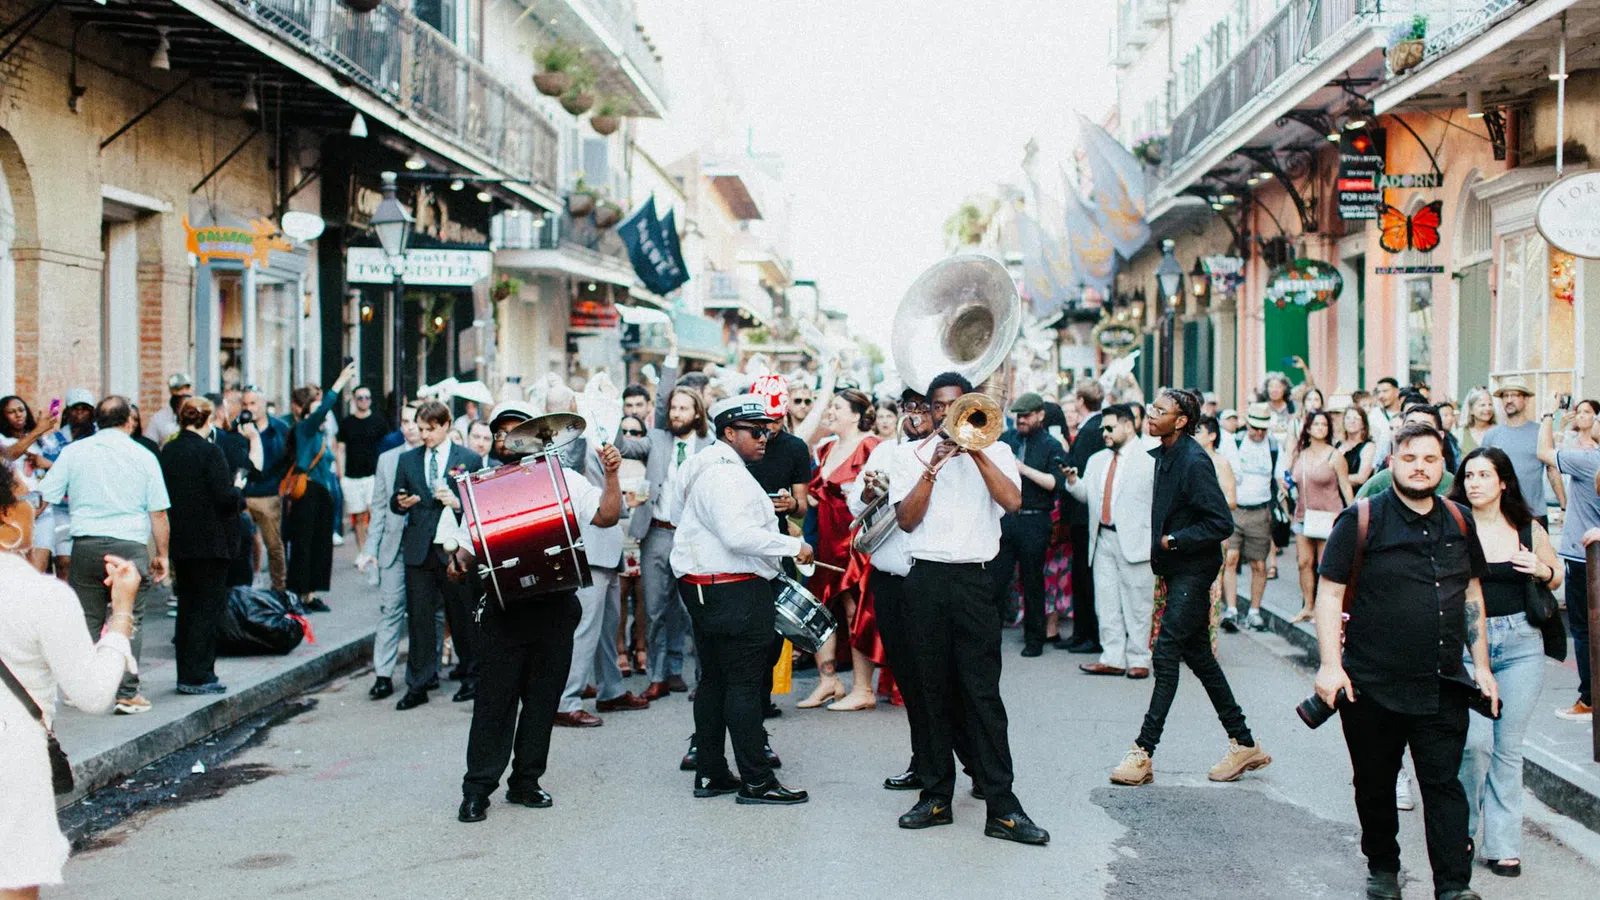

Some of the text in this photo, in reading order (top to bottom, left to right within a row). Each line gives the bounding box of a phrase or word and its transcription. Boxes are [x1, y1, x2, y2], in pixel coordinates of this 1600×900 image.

[1379, 175, 1437, 187] ADORN
[1341, 193, 1358, 201] FOR
[356, 263, 480, 277] TWO SISTERS
